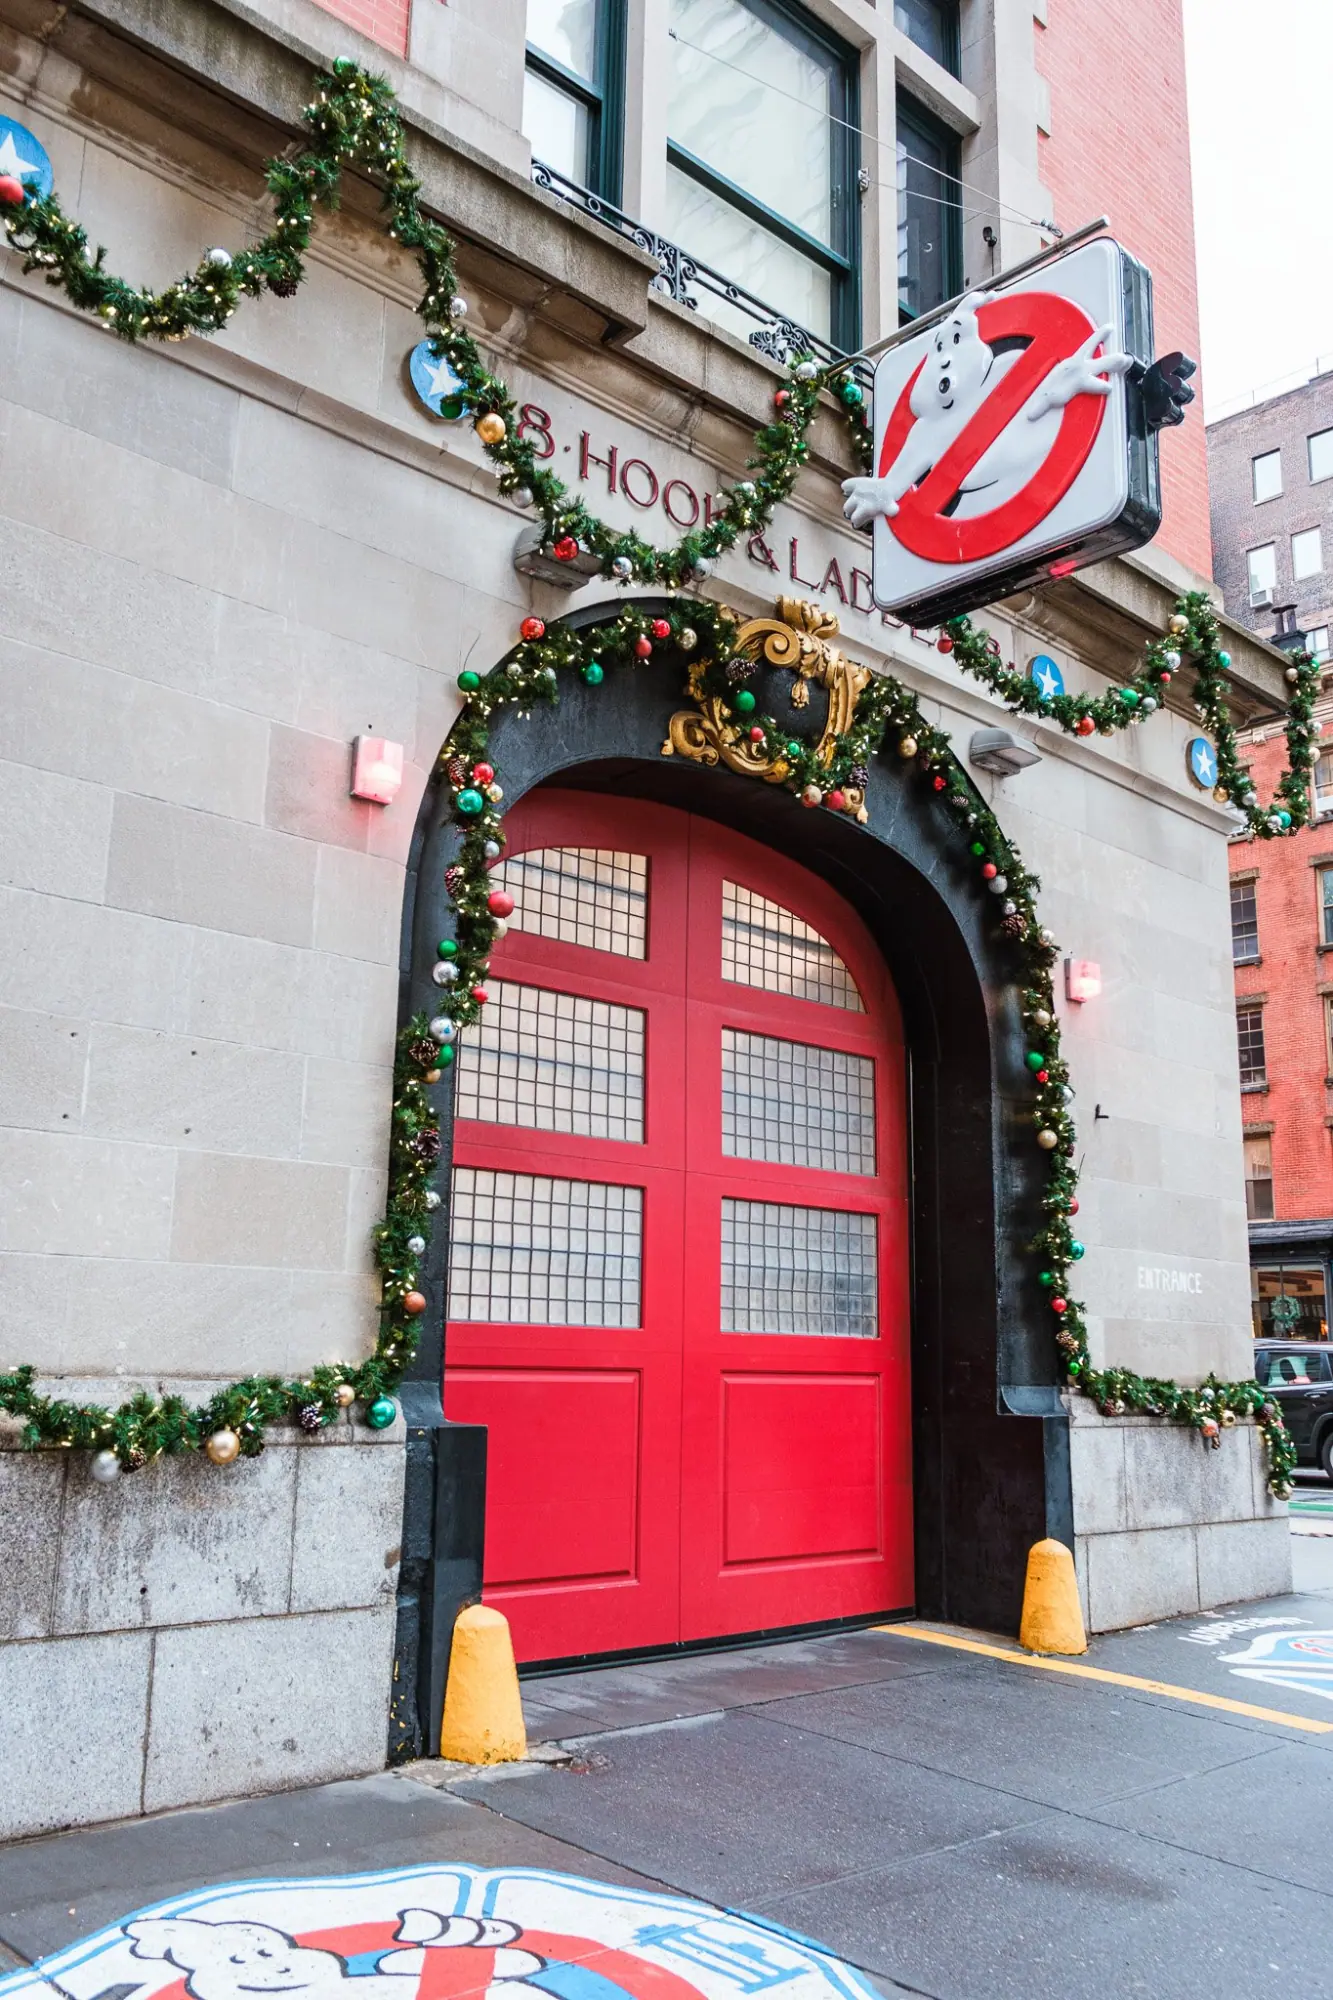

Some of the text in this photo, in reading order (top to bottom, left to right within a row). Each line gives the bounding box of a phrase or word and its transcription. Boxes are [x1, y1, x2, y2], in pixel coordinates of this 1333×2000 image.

[517, 403, 556, 459] 8
[747, 521, 781, 573] &
[1137, 1266, 1203, 1294] ENTRANCE
